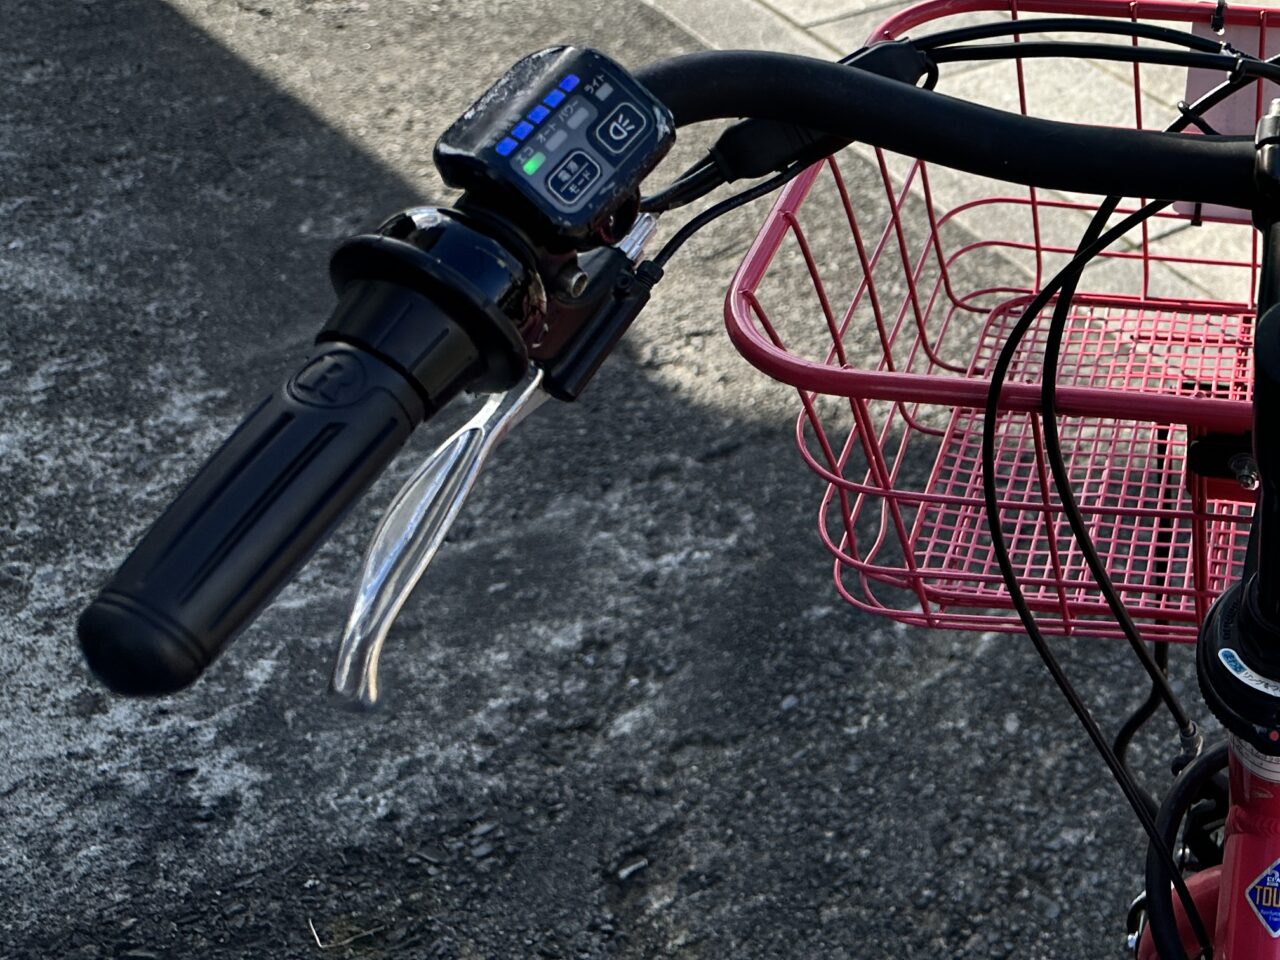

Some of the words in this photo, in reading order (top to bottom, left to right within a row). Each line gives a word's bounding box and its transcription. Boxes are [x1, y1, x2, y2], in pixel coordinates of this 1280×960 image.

[584, 74, 605, 93] ライト
[559, 100, 579, 122] パワー
[537, 122, 557, 143] オート
[516, 146, 533, 164] エコ
[569, 171, 592, 194] モード
